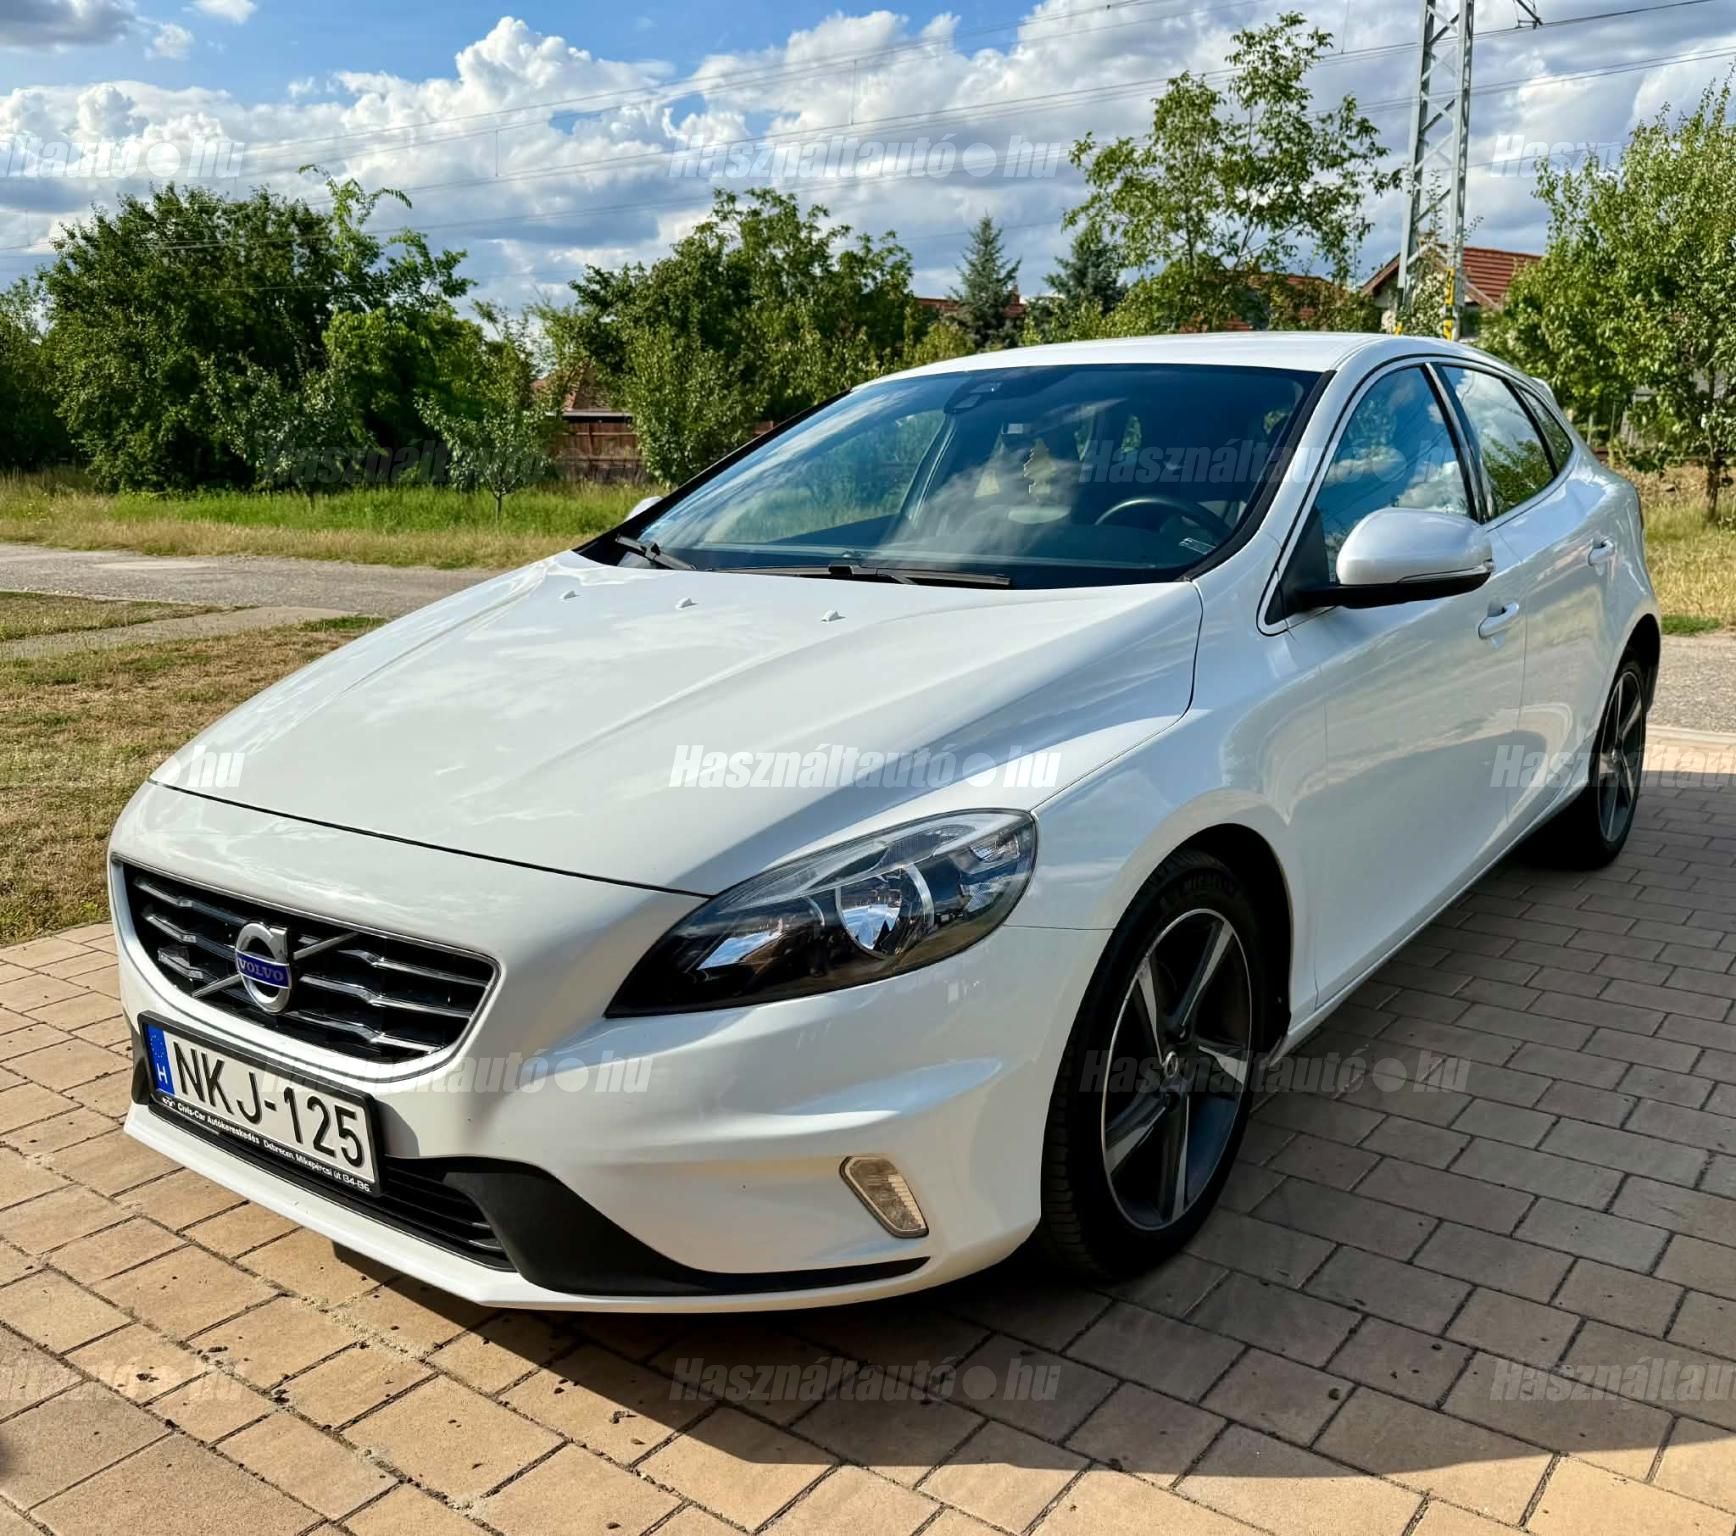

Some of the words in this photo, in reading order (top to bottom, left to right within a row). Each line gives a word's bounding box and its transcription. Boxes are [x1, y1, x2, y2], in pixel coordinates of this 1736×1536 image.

[238, 957, 284, 981] VOLVO
[156, 1066, 168, 1086] H
[173, 1041, 363, 1168] NKJ-125
